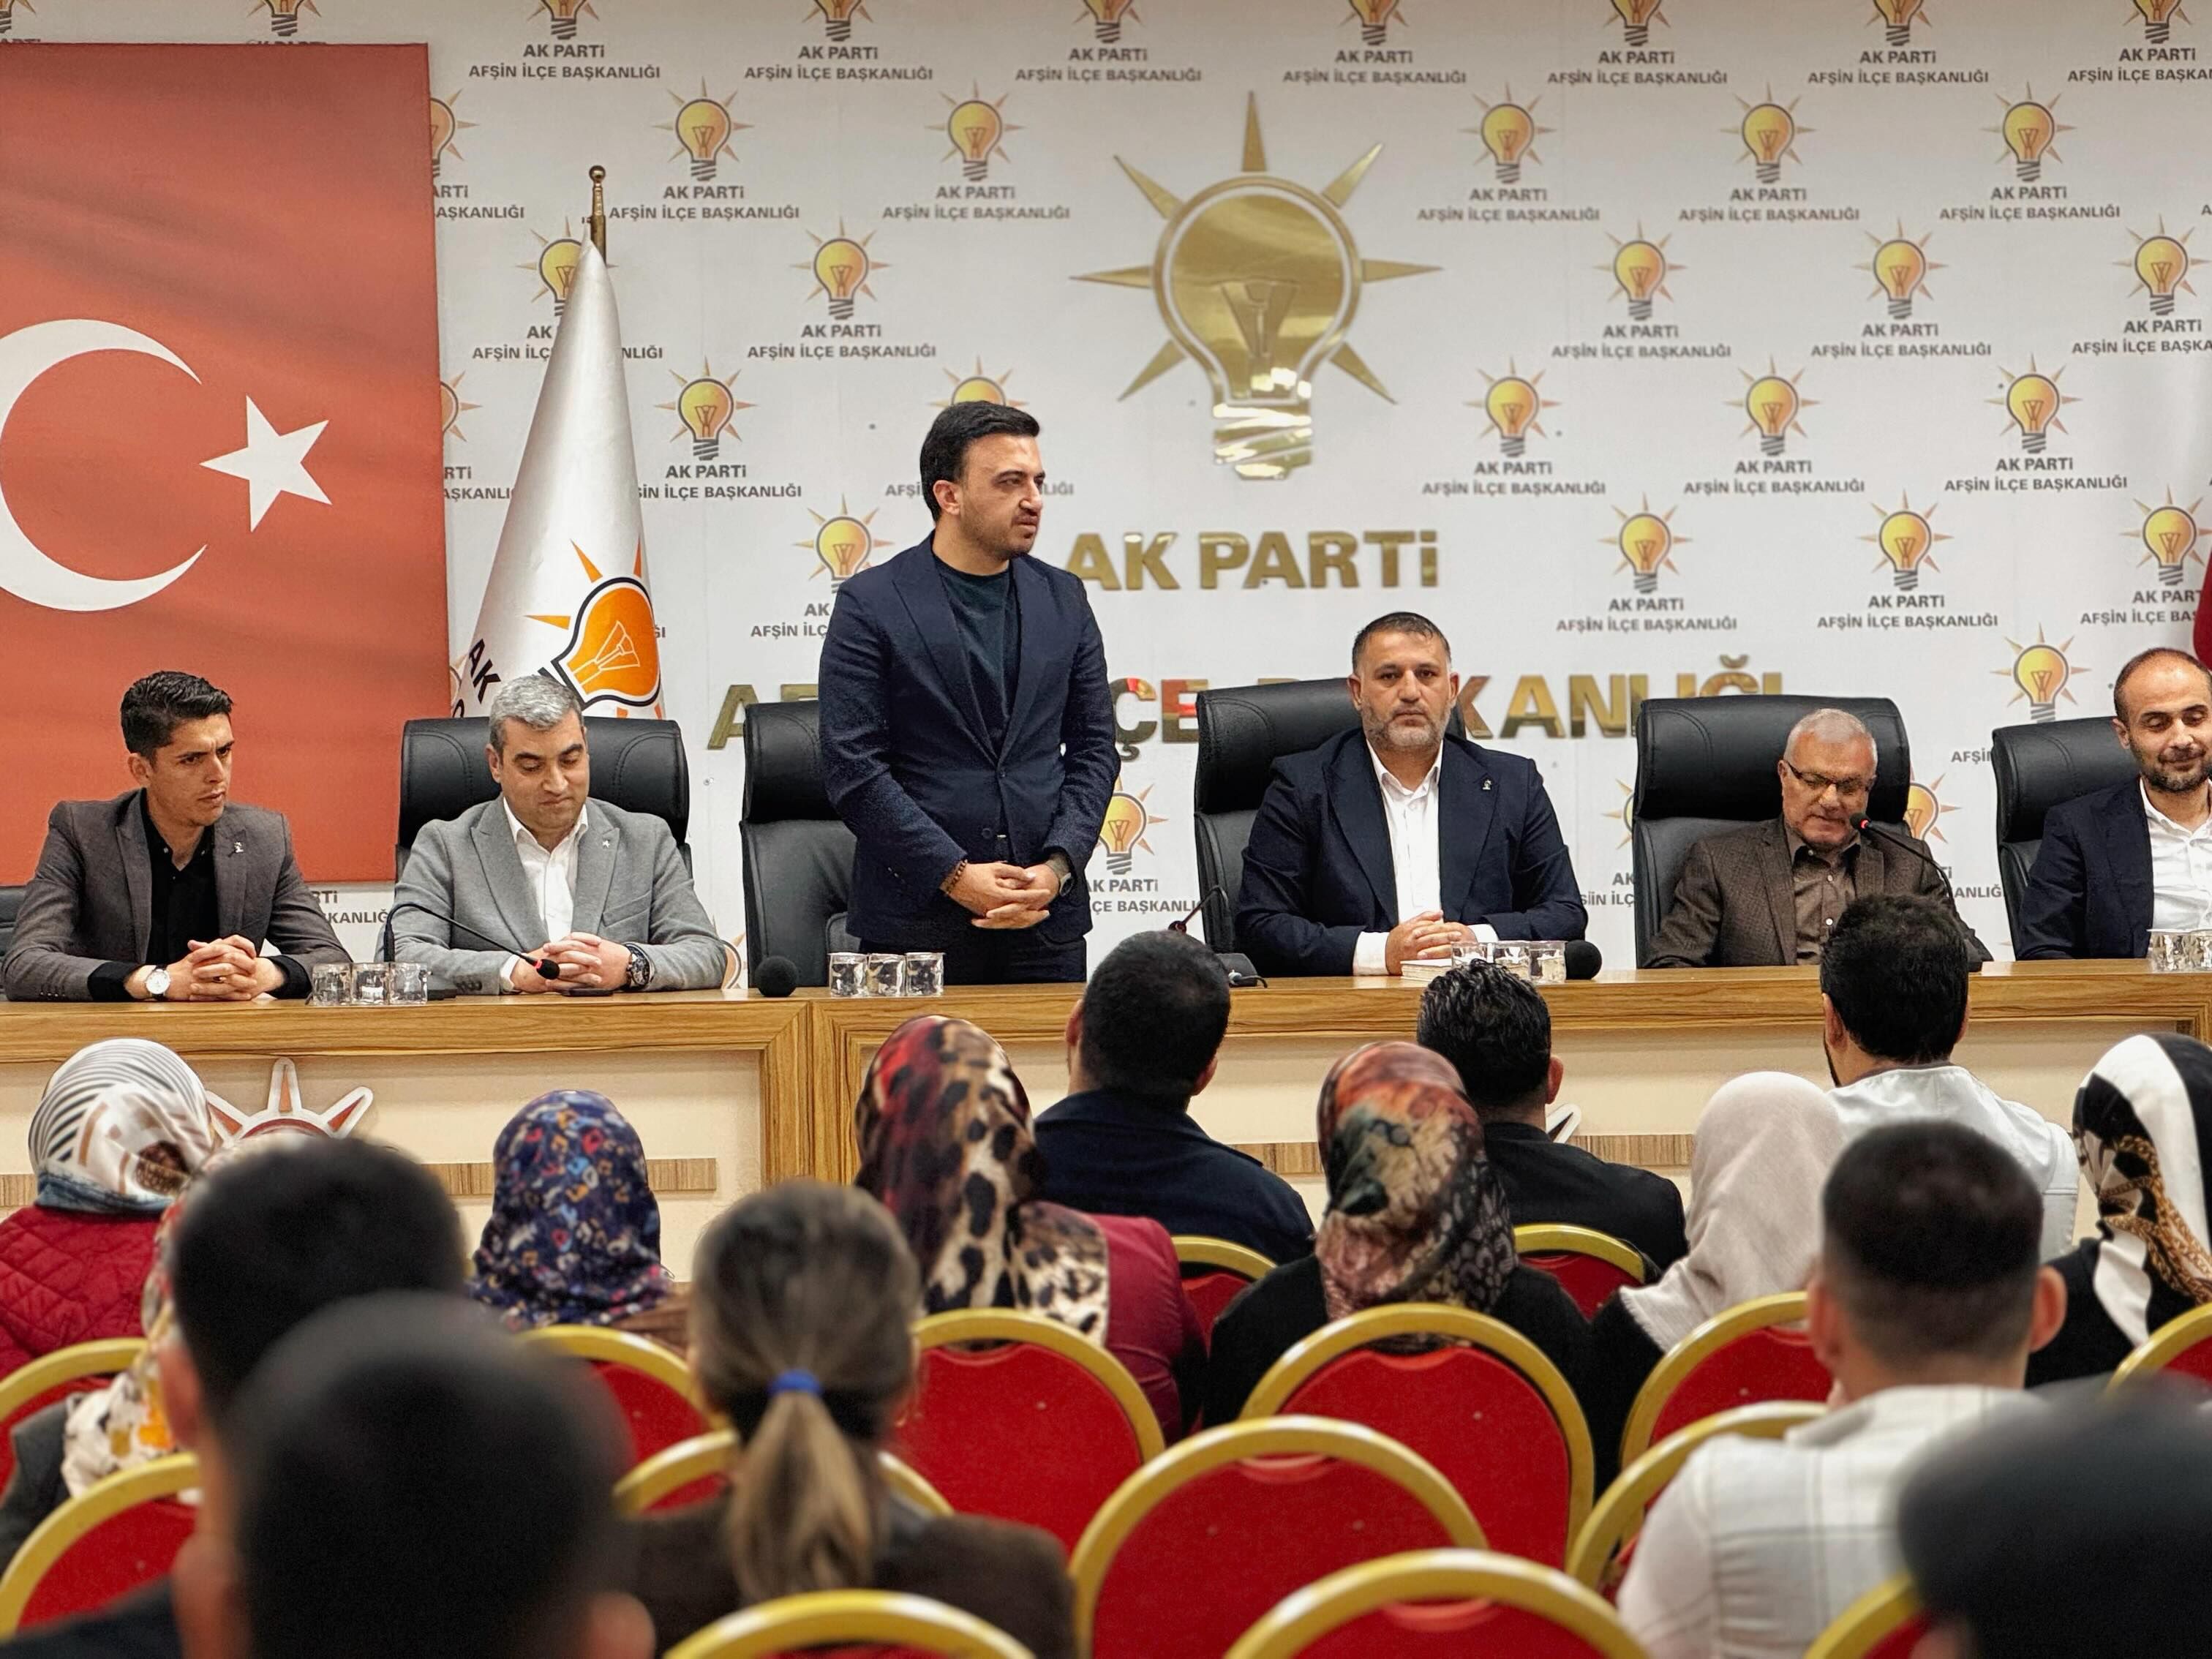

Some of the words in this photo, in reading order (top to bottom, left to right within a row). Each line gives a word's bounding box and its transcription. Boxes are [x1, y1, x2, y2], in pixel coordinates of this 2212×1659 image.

[523, 44, 549, 58] AK
[798, 45, 824, 59] AK
[1069, 48, 1094, 61] AK
[1335, 50, 1360, 63] AK
[1598, 50, 1622, 64] AK
[1859, 50, 1884, 64] AK
[2118, 48, 2143, 62] AK
[469, 62, 517, 80] AFŞİN
[522, 62, 557, 80] İLÇE
[562, 64, 661, 80] BAŞKANLIĞI
[744, 64, 792, 81] AFŞİN
[797, 64, 832, 82] İLÇE
[836, 66, 933, 82] BAŞKANLIĞI
[1015, 67, 1062, 83] AFŞİN
[1067, 67, 1101, 83] İLÇE
[1106, 67, 1202, 83] BAŞKANLIĞI
[1283, 68, 1329, 84] AFŞİN
[1333, 68, 1366, 85] İLÇE
[1372, 69, 1467, 85] BAŞKANLIĞI
[1547, 69, 1592, 86] AFŞİN
[1597, 69, 1629, 86] İLÇE
[1634, 69, 1728, 86] BAŞKANLIĞI
[1808, 69, 1854, 86] AFŞİN
[1858, 69, 1891, 85] İLÇE
[1895, 69, 1989, 86] BAŞKANLIĞI
[2067, 67, 2113, 84] AFŞİN
[2118, 67, 2151, 83] İLÇE
[2155, 68, 2212, 83] BAŞKA
[663, 186, 689, 199] AK
[936, 186, 961, 199] AK
[1470, 188, 1494, 201] AK
[1730, 188, 1754, 201] AK
[1990, 187, 2014, 200] AK
[436, 205, 524, 221] AŞKANLIĞI
[608, 204, 657, 221] AFŞİN
[662, 204, 696, 222] İLÇE
[701, 204, 800, 222] BAŞKANLIĞI
[882, 204, 930, 221] AFŞİN
[934, 204, 968, 222] İLÇE
[973, 205, 1070, 221] BAŞKANLIĞI
[1417, 206, 1464, 223] AFŞİN
[1468, 207, 1501, 223] İLÇE
[1506, 206, 1600, 223] BAŞKANLIĞI
[1679, 207, 1724, 223] AFŞİN
[1728, 207, 1761, 223] İLÇE
[1766, 206, 1859, 223] BAŞKANLIĞI
[1939, 206, 1985, 222] AFŞİN
[1989, 206, 2022, 222] İLÇE
[2026, 203, 2121, 220] BAŞKANLIĞI
[527, 326, 552, 339] AK
[801, 324, 827, 338] AK
[1603, 325, 1627, 338] AK
[1862, 324, 1886, 337] AK
[2123, 320, 2148, 334] AK
[472, 344, 520, 361] AFŞİN
[525, 344, 552, 361] İLÇ
[747, 343, 795, 361] AFŞİN
[800, 343, 834, 360] İLÇE
[839, 343, 936, 360] BAŞKANLIĞI
[1551, 343, 1598, 359] AFŞİN
[1601, 344, 1633, 360] İLÇE
[1638, 343, 1731, 360] BAŞKANLIĞI
[1810, 342, 1856, 359] AFŞİN
[1861, 342, 1893, 358] İLÇE
[1898, 342, 1992, 358] BAŞKANLIĞI
[2072, 339, 2118, 356] AFŞİN
[2123, 338, 2156, 356] İLÇE
[2161, 339, 2212, 354] BAŞKA
[665, 464, 691, 479] AK
[1474, 462, 1499, 475] AK
[1734, 460, 1759, 474] AK
[1995, 458, 2020, 471] AK
[885, 483, 922, 498] AFŞİ
[1422, 481, 1469, 497] AFŞİN
[1473, 481, 1506, 497] İLÇE
[1511, 481, 1606, 497] BAŞKANLIĞI
[1684, 479, 1729, 496] AFŞİN
[1734, 479, 1766, 495] İLÇE
[1771, 478, 1865, 495] BAŞKANLIĞI
[1944, 476, 1990, 494] AFŞİN
[1995, 476, 2028, 493] İLÇE
[2033, 474, 2128, 492] BAŞKANLIĞI
[664, 484, 699, 502] İLÇE
[704, 483, 802, 500] BAŞKANLIĞI
[1065, 533, 1181, 590] AK
[1868, 595, 1892, 609] AK
[2132, 590, 2157, 603] AK
[804, 603, 830, 617] AK
[1609, 598, 1632, 612] AK
[1556, 617, 1603, 633] AFŞİN
[1607, 616, 1639, 633] İLÇE
[1644, 616, 1737, 633] BAŞKANLIĞI
[1817, 614, 1862, 631] AFŞİN
[1867, 614, 1900, 631] İLÇE
[1905, 612, 1998, 630] BAŞKANLIĞI
[2080, 609, 2127, 626] AFŞİN
[2132, 608, 2166, 625] İLÇE
[750, 622, 798, 639] AFŞİN
[803, 622, 828, 639] İLÇ
[468, 639, 502, 704] AK
[1951, 747, 1991, 764] AFŞİ
[1611, 872, 1635, 886] AK
[1611, 890, 1634, 908] İLÇ
[1091, 900, 1113, 915] ÇE
[1117, 900, 1201, 914] BAŞKANLI
